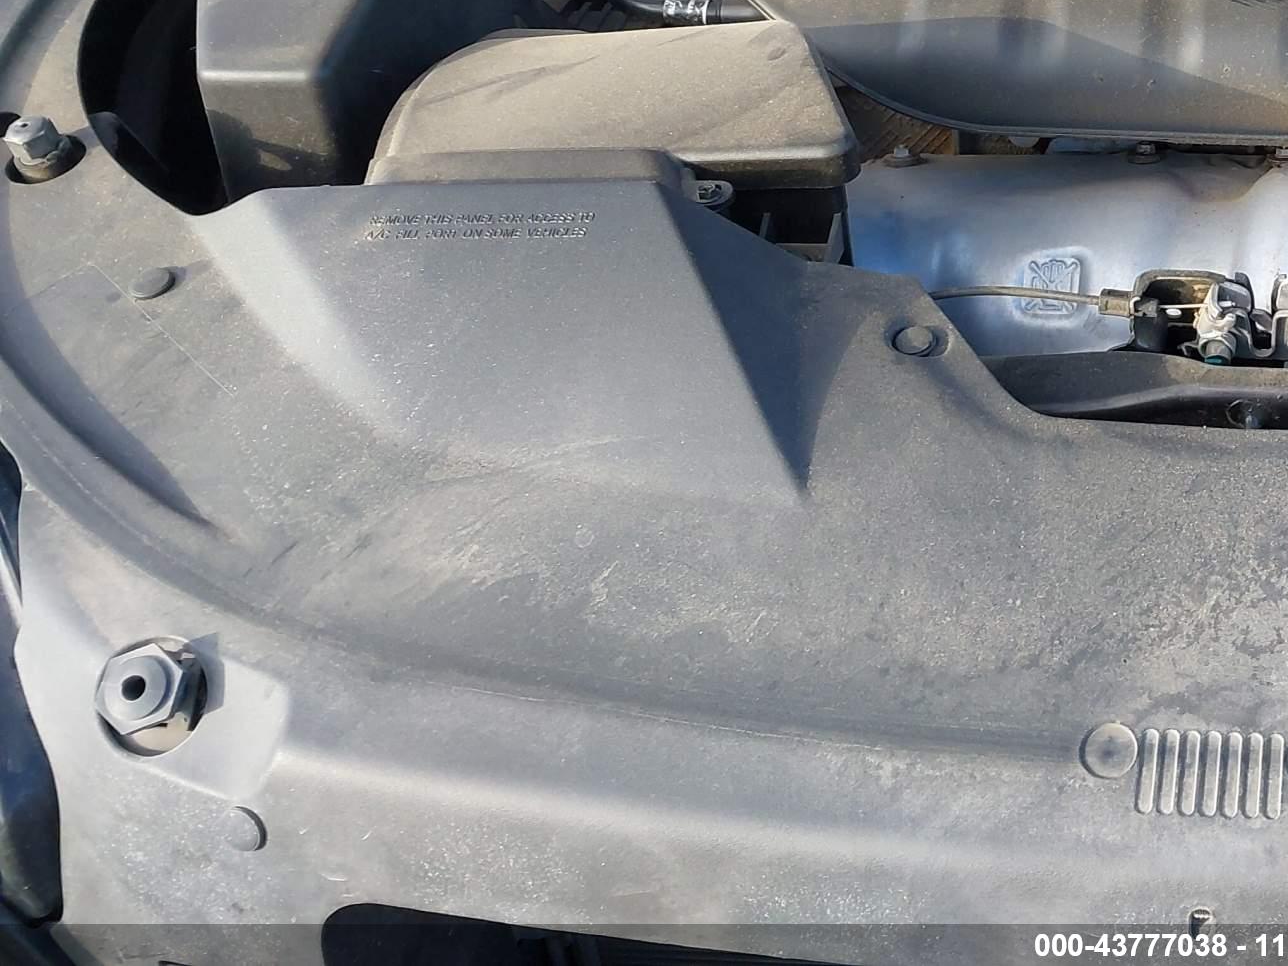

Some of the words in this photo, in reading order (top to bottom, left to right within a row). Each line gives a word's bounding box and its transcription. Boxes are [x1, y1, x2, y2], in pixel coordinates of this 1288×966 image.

[369, 214, 420, 226] REMOVE
[424, 213, 454, 225] THIS
[455, 213, 494, 225] PANEL
[498, 213, 524, 224] FOR
[527, 212, 577, 224] ACCESS
[579, 212, 596, 223] TO
[395, 229, 420, 240] FILL
[425, 228, 457, 240] PORT
[462, 228, 483, 240] ON
[484, 228, 522, 239] SOME
[527, 227, 588, 239] VEHICLES
